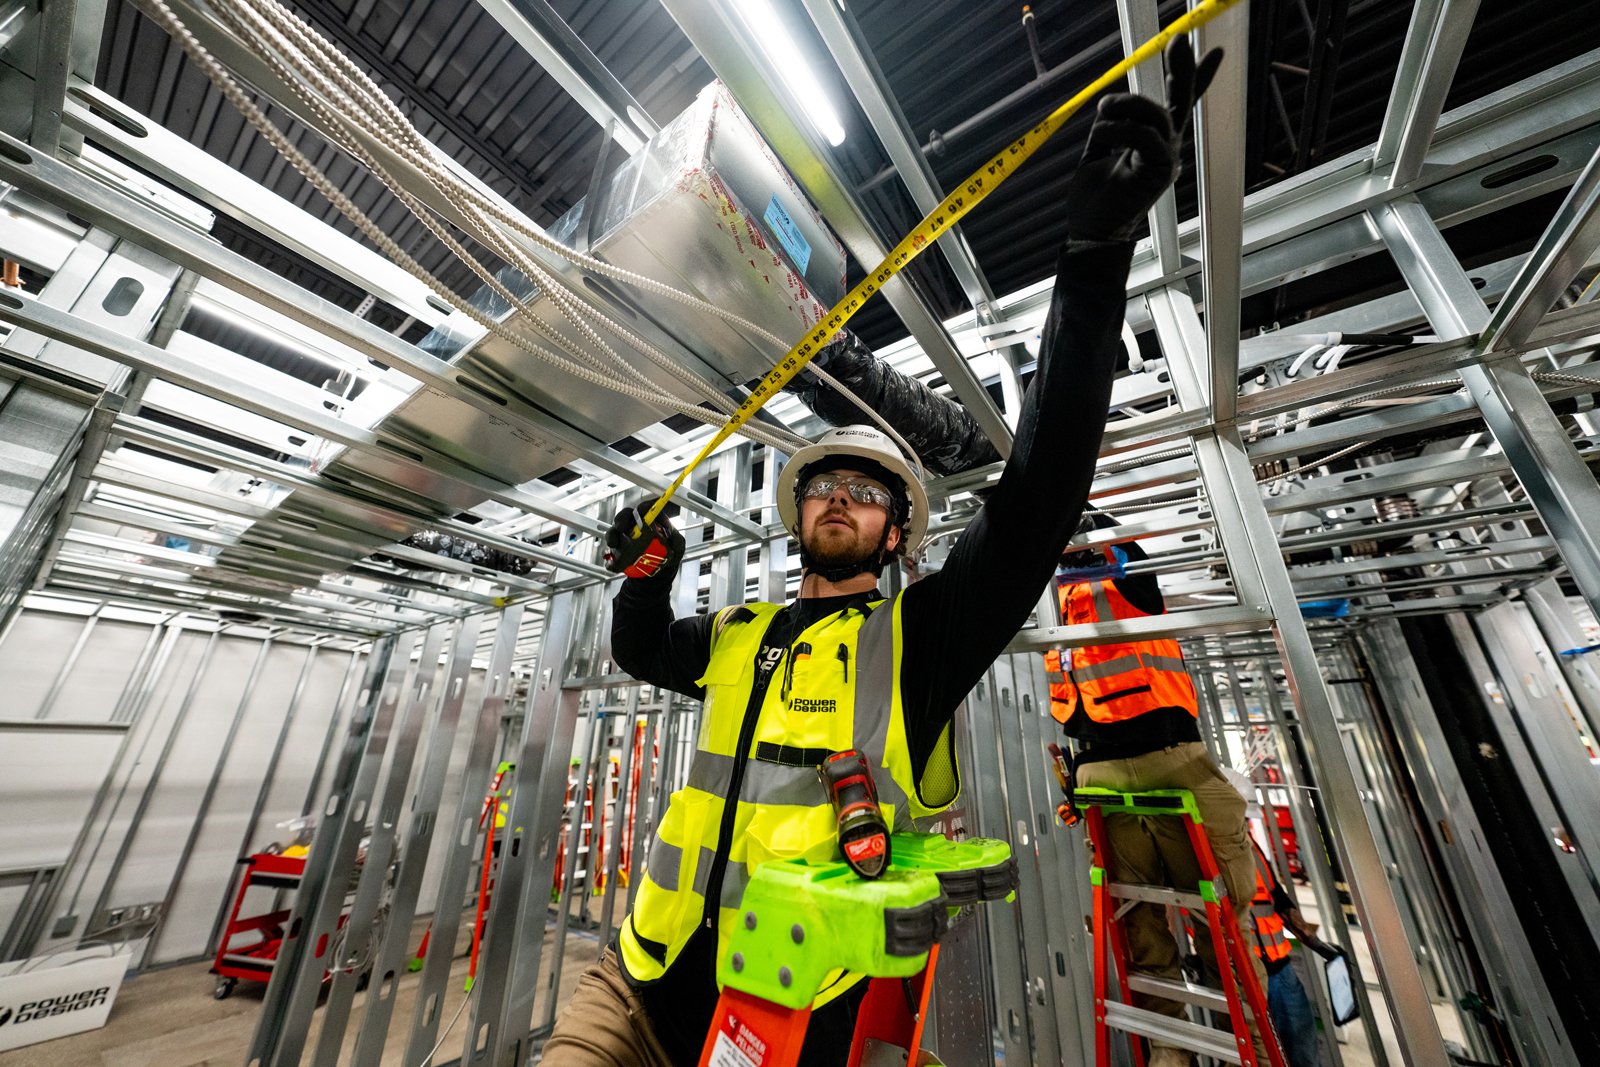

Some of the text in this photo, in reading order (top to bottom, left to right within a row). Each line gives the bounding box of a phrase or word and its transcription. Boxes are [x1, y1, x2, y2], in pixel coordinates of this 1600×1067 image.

[967, 177, 983, 195] 45
[948, 196, 964, 214] 46
[931, 216, 945, 233] 47
[894, 251, 908, 266] 49
[877, 268, 892, 283] 50
[861, 284, 875, 299] 51
[844, 299, 859, 314] 52
[828, 314, 842, 329] 53
[813, 329, 827, 344] 54
[797, 343, 812, 358] 55
[783, 357, 797, 371] 56
[769, 371, 782, 385] 57
[754, 386, 767, 398] 58
[740, 399, 754, 411] 59
[739, 1023, 767, 1055] DANGER
[735, 1034, 763, 1067] PELIGRO
